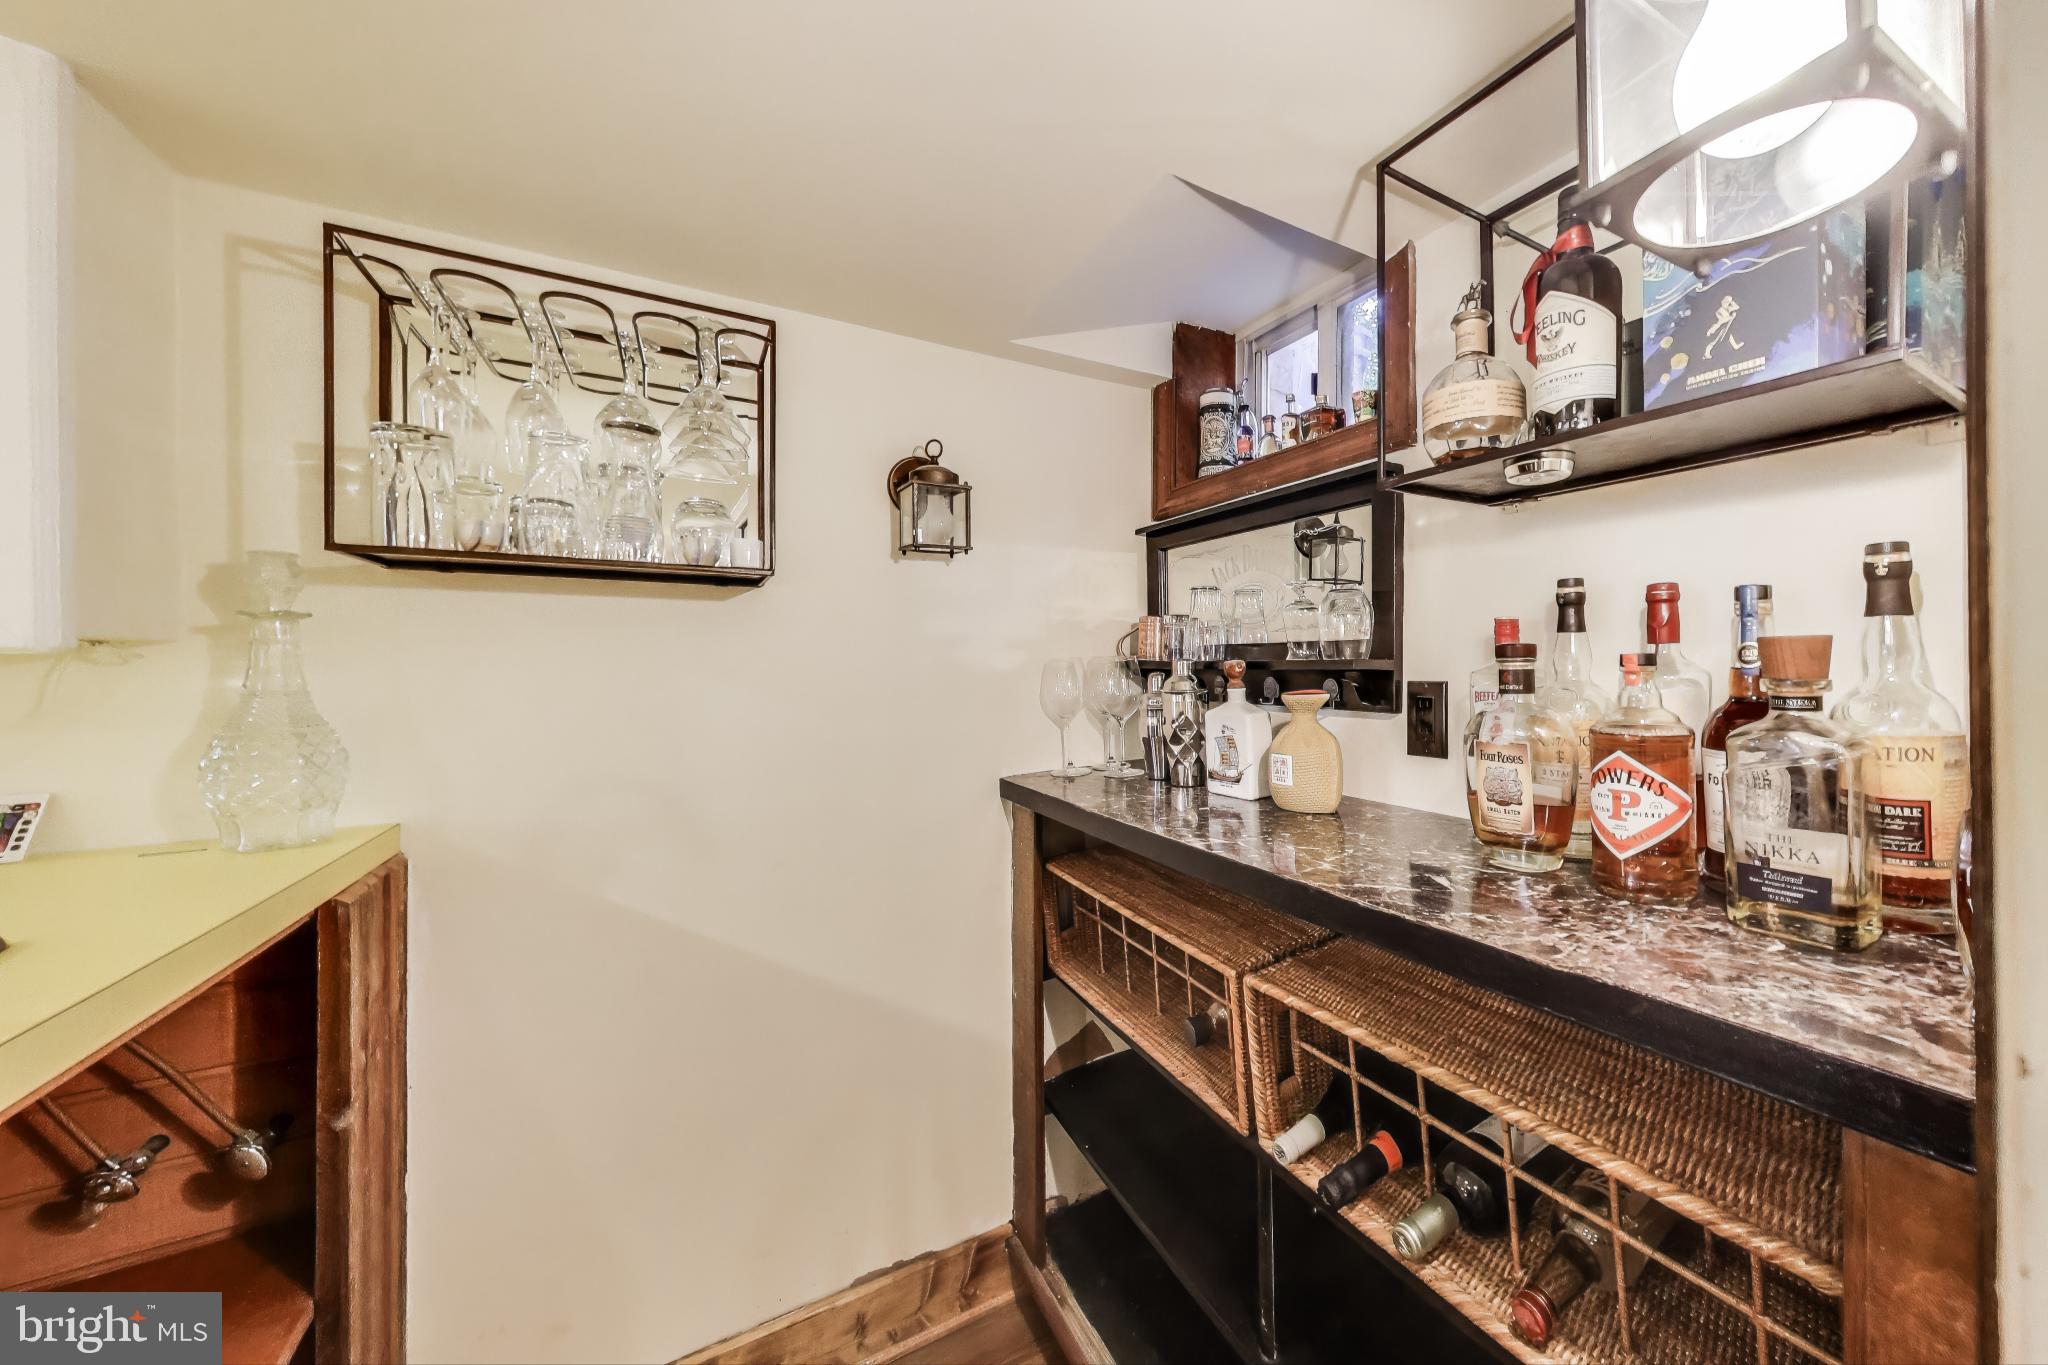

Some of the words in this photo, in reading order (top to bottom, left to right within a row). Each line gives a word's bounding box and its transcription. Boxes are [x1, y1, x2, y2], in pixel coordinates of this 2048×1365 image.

[1536, 308, 1587, 336] EELING
[1607, 788, 1643, 823] P
[1884, 805, 1923, 817] DARK
